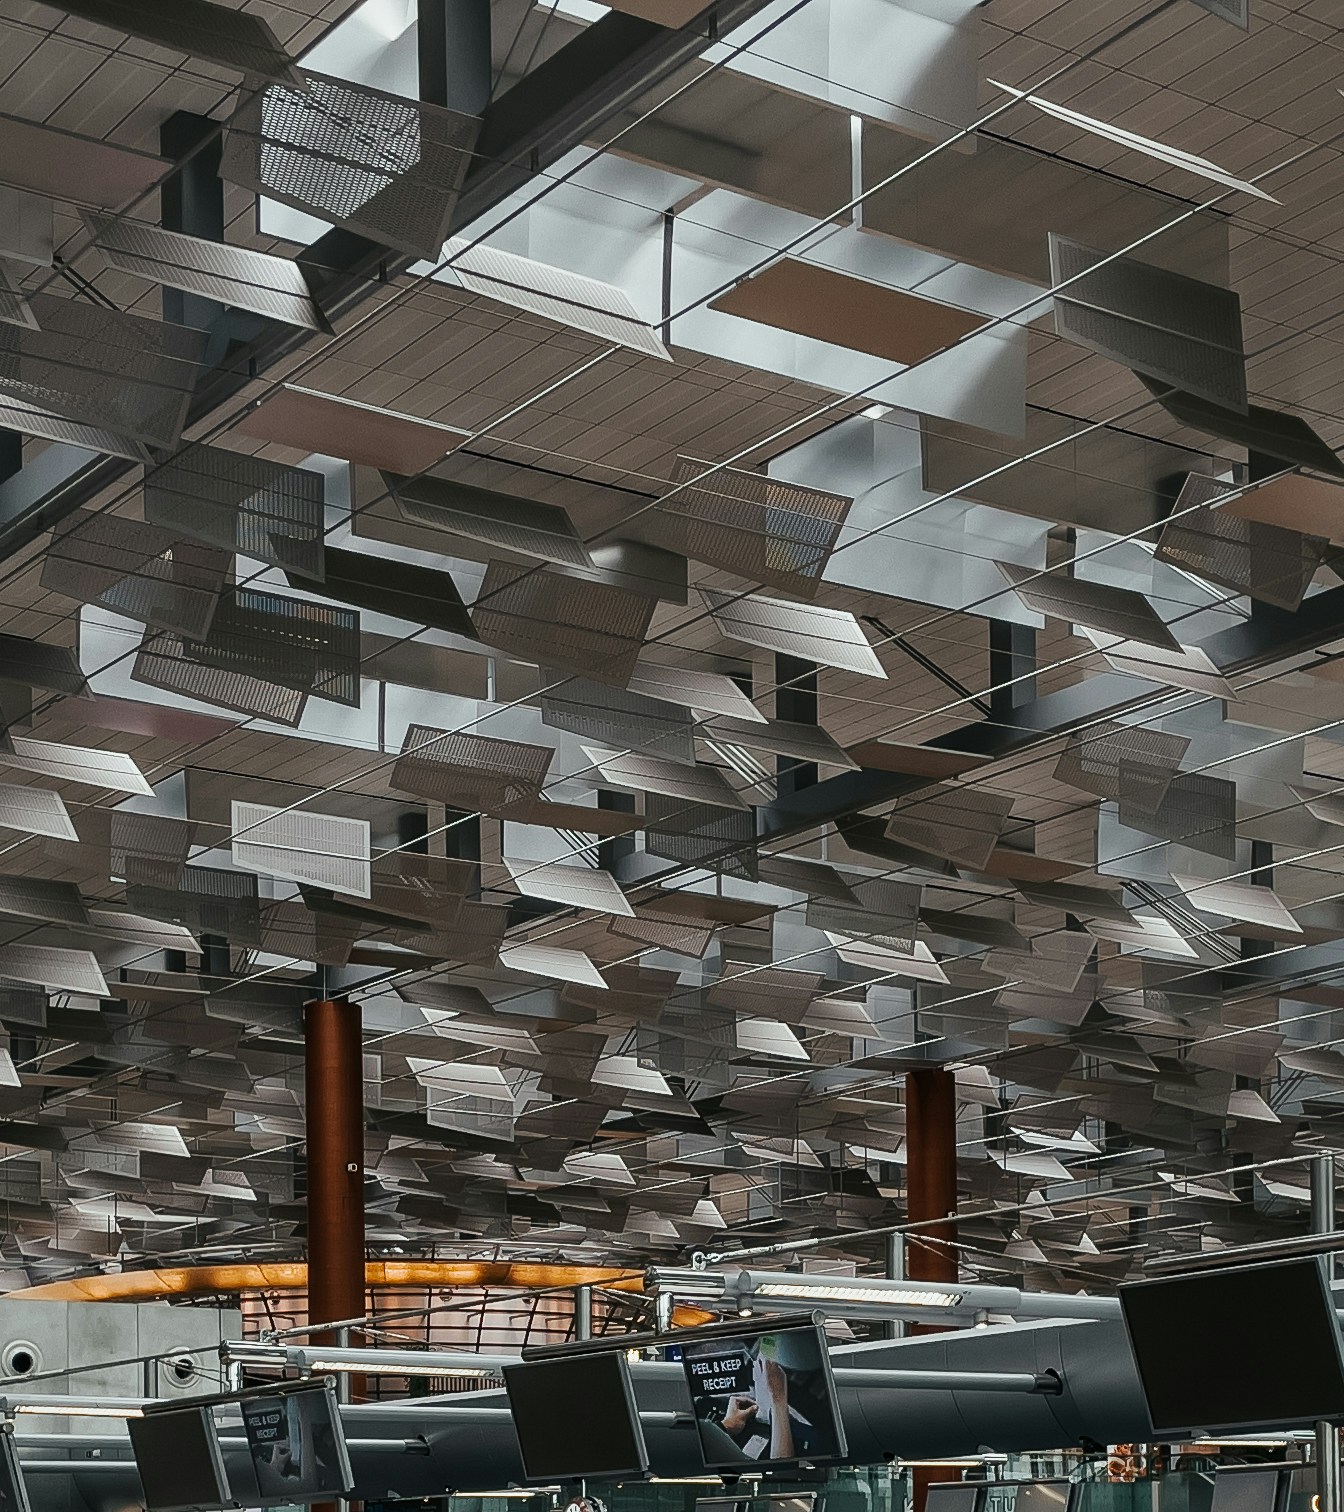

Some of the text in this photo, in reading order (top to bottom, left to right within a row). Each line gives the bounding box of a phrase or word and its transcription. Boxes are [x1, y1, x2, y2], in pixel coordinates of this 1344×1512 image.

[692, 1359, 742, 1375] PEEL & KEEP
[703, 1377, 736, 1390] RECEIPT
